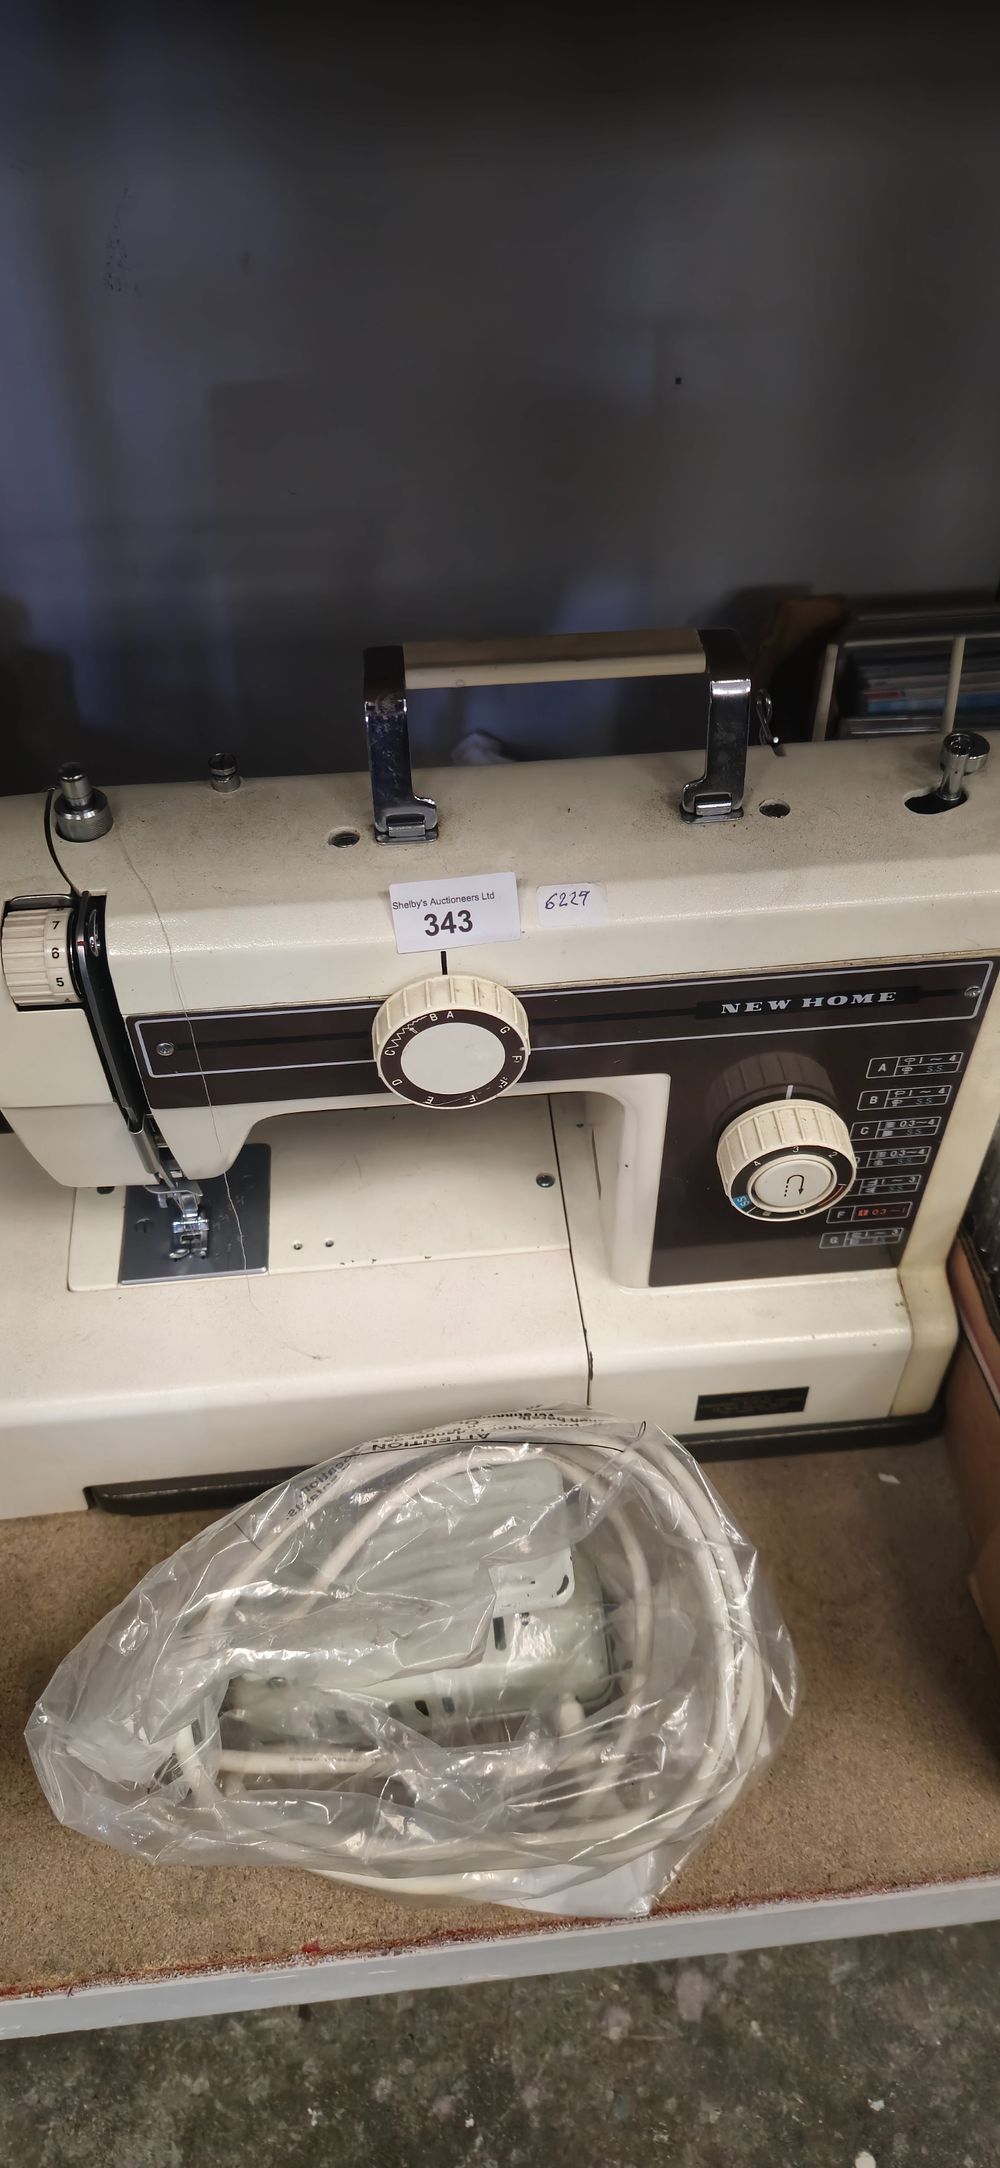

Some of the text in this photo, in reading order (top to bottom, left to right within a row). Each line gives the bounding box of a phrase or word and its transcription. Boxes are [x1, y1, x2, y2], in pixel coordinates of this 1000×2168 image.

[392, 892, 495, 910] Shelby's Auctioneers Ltd
[52, 921, 60, 930] 7
[424, 910, 473, 936] 343
[51, 947, 60, 959] 6
[56, 977, 64, 987] 5
[720, 991, 897, 1014] NEW HOME
[429, 1011, 454, 1022] B A
[878, 1063, 887, 1072] A
[869, 1096, 879, 1104] B
[860, 1126, 869, 1135] C
[372, 1433, 490, 1450] ATTENTION
